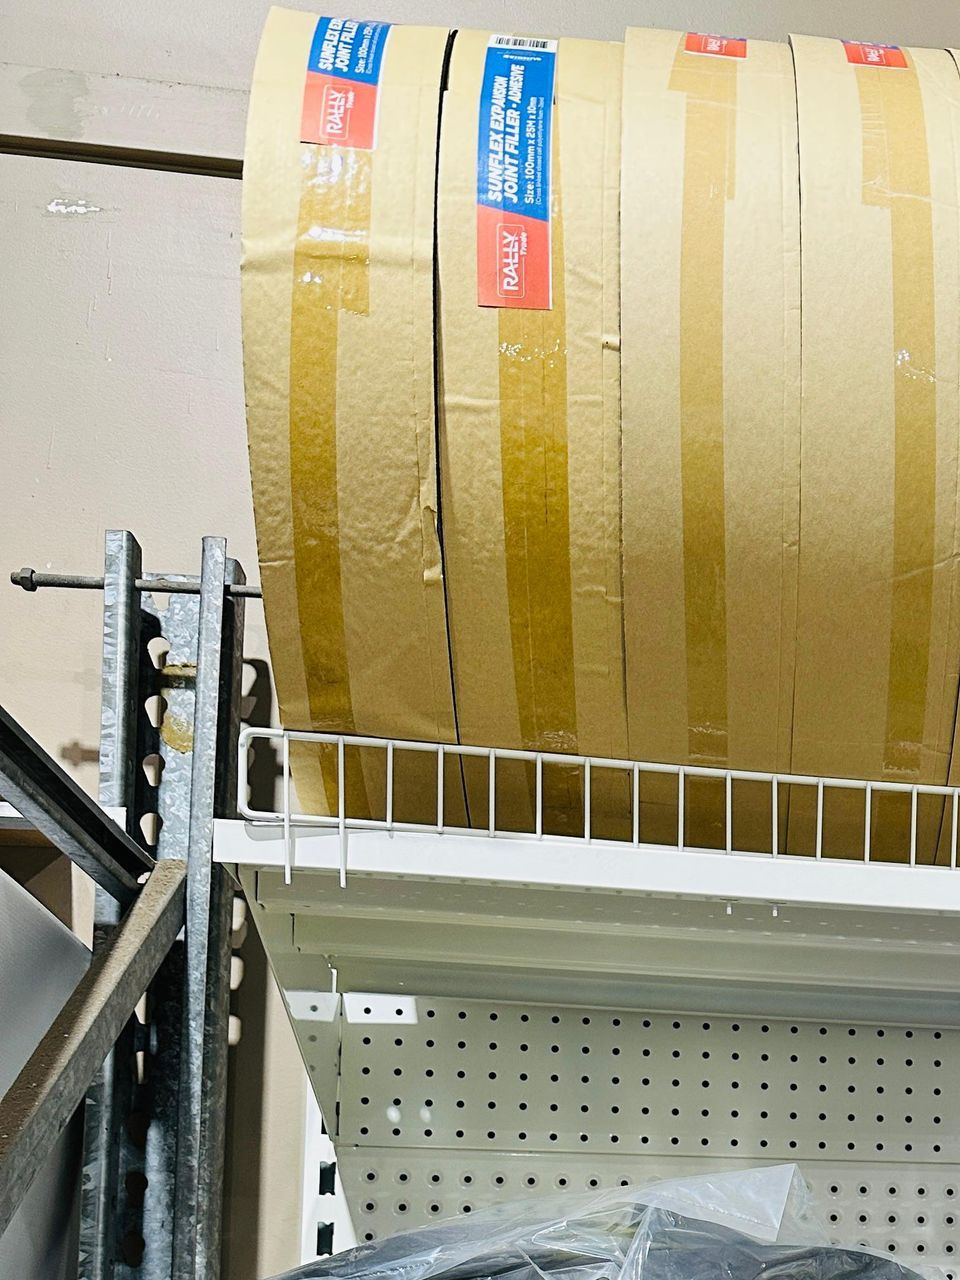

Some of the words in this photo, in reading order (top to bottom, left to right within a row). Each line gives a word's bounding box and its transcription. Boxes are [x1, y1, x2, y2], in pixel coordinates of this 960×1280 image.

[319, 30, 340, 70] SUNFLEX
[335, 42, 353, 72] JOINT
[490, 75, 508, 131] EXPANSION
[508, 64, 525, 103] ADHESIVE
[326, 90, 345, 134] RALLY
[504, 109, 520, 154] FILLER
[526, 120, 536, 138] 25M
[488, 131, 505, 202] SUNFLEX
[503, 154, 519, 204] JOINT
[525, 145, 535, 180] 100mm
[525, 181, 534, 204] Size:
[502, 231, 519, 291] RALLY
